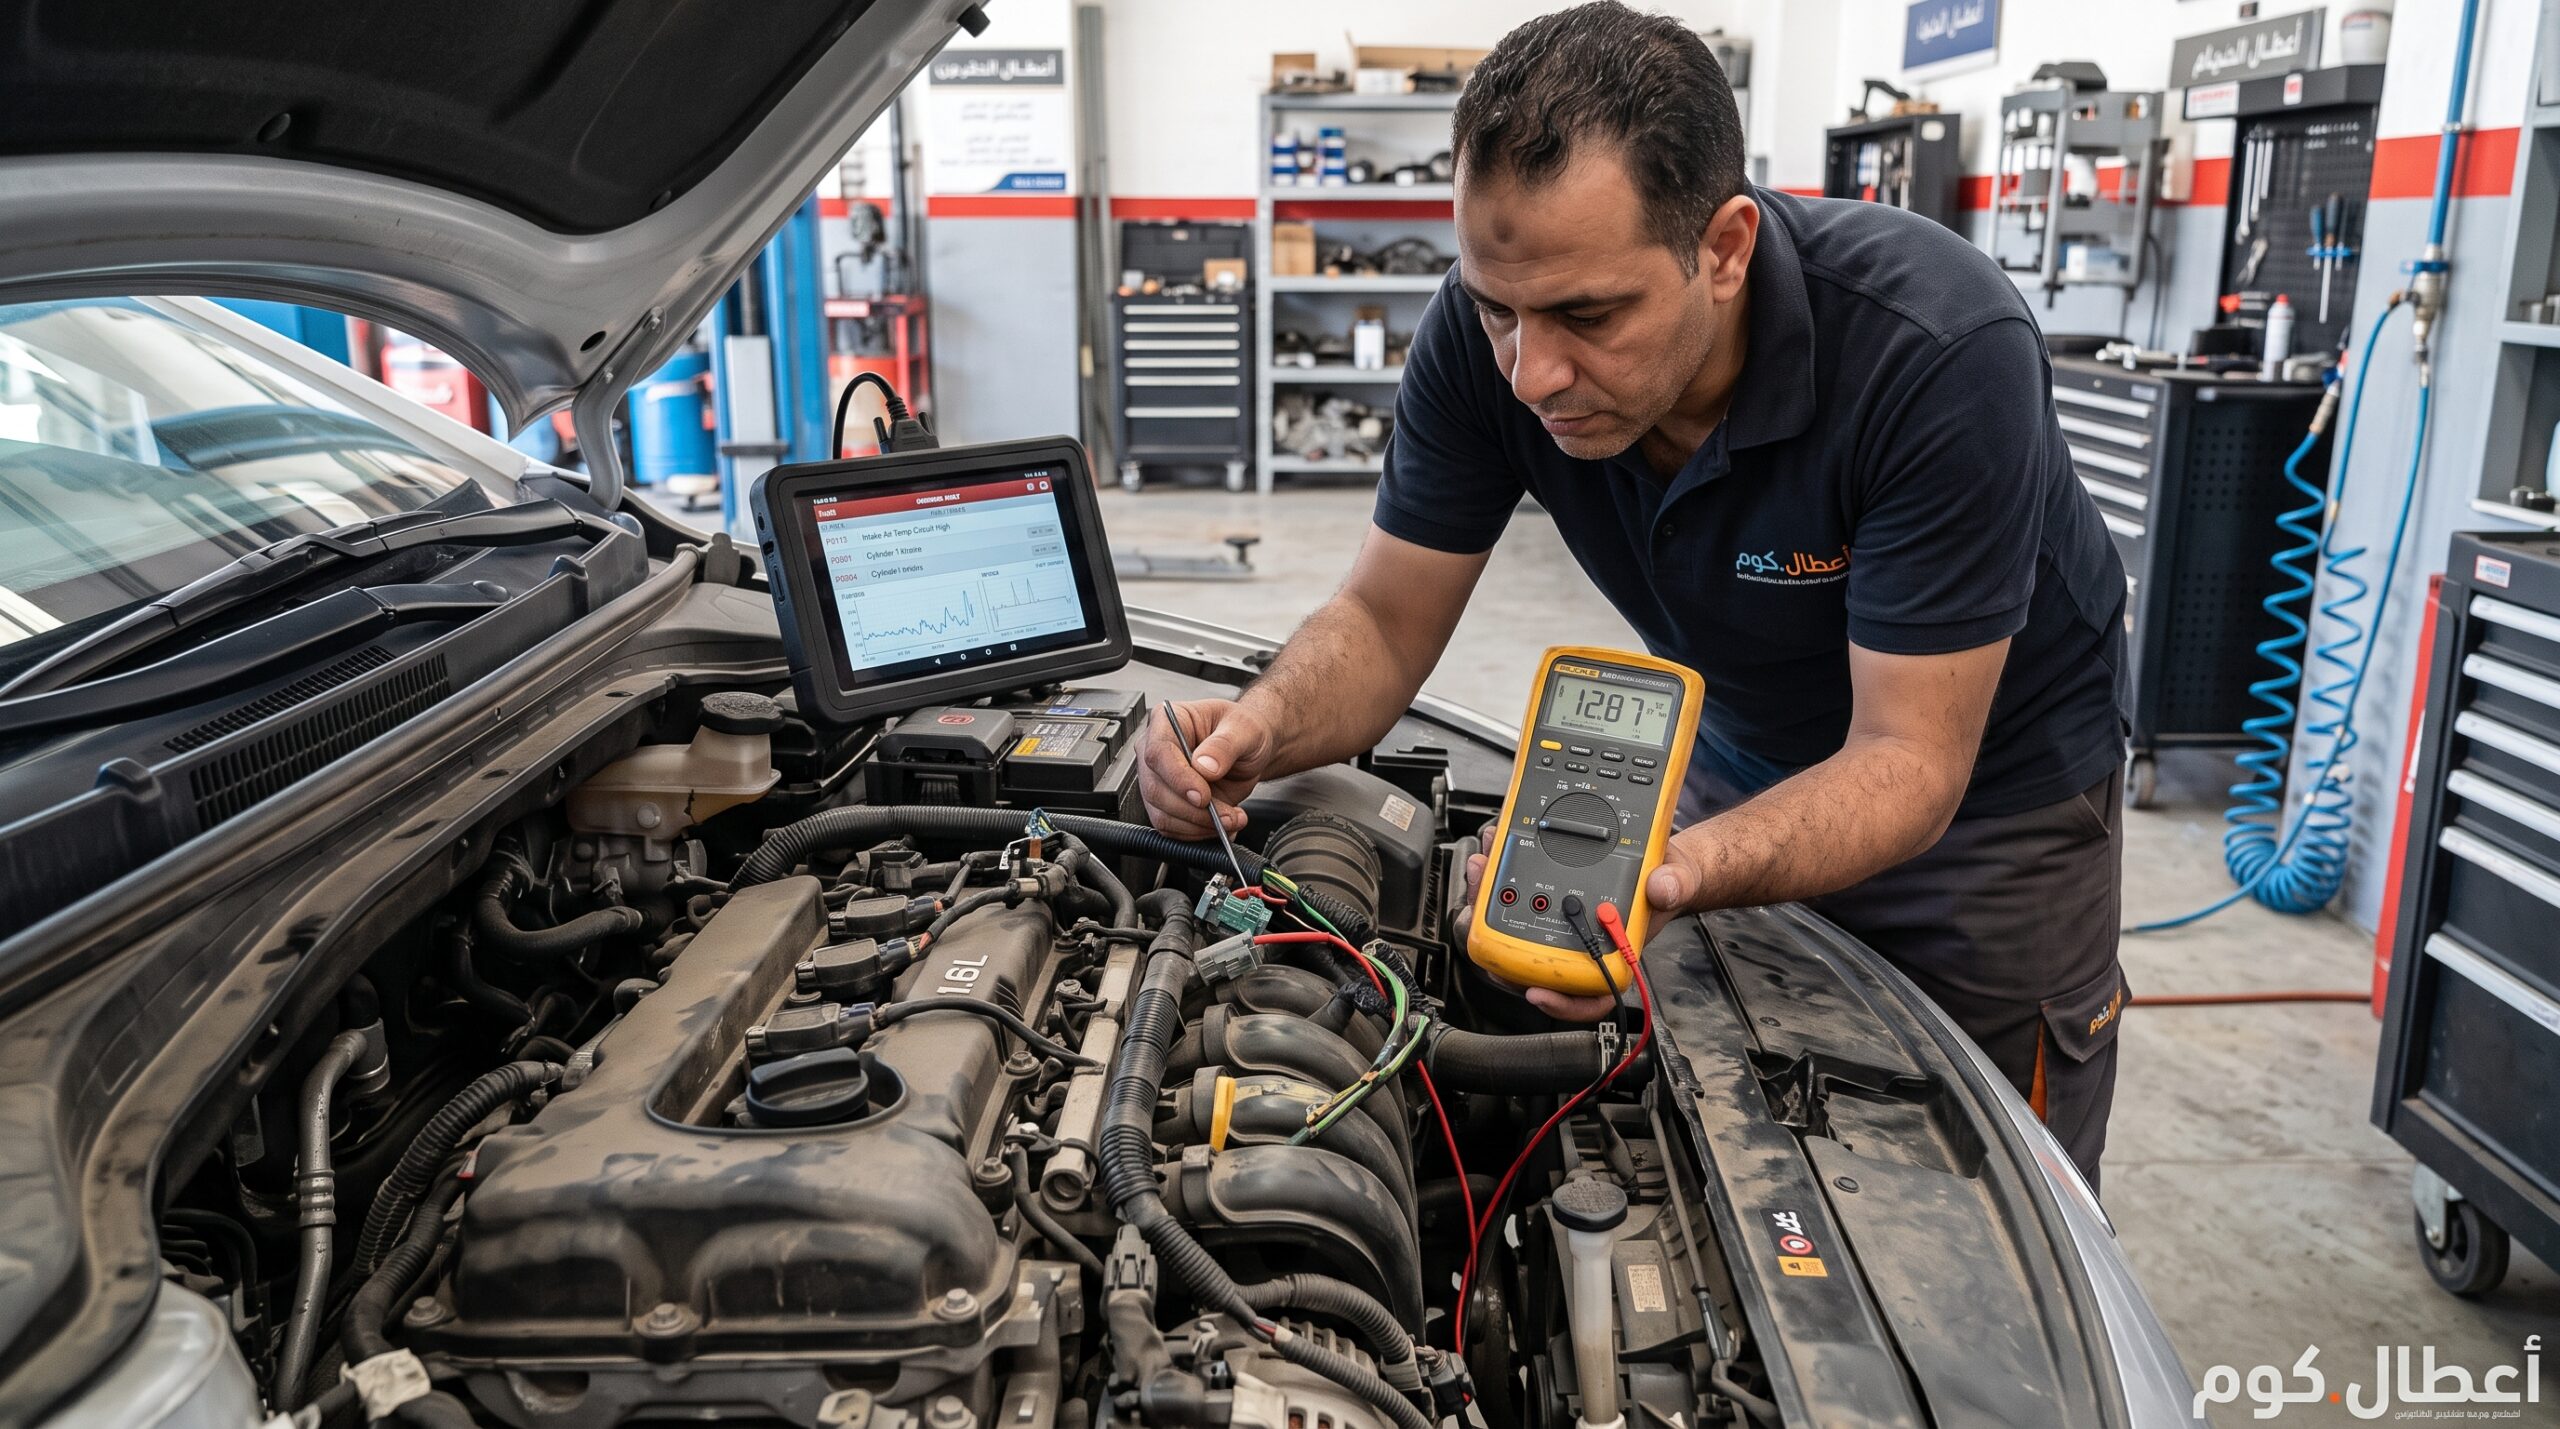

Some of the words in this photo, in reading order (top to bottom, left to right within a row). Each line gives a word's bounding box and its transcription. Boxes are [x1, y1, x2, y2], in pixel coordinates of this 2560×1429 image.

[862, 532, 882, 541] Intake
[894, 529, 912, 537] Temp
[913, 525, 934, 534] Circuit
[936, 523, 951, 532] High
[1575, 689, 1644, 726] 12.87
[936, 955, 988, 994] 1.6L
